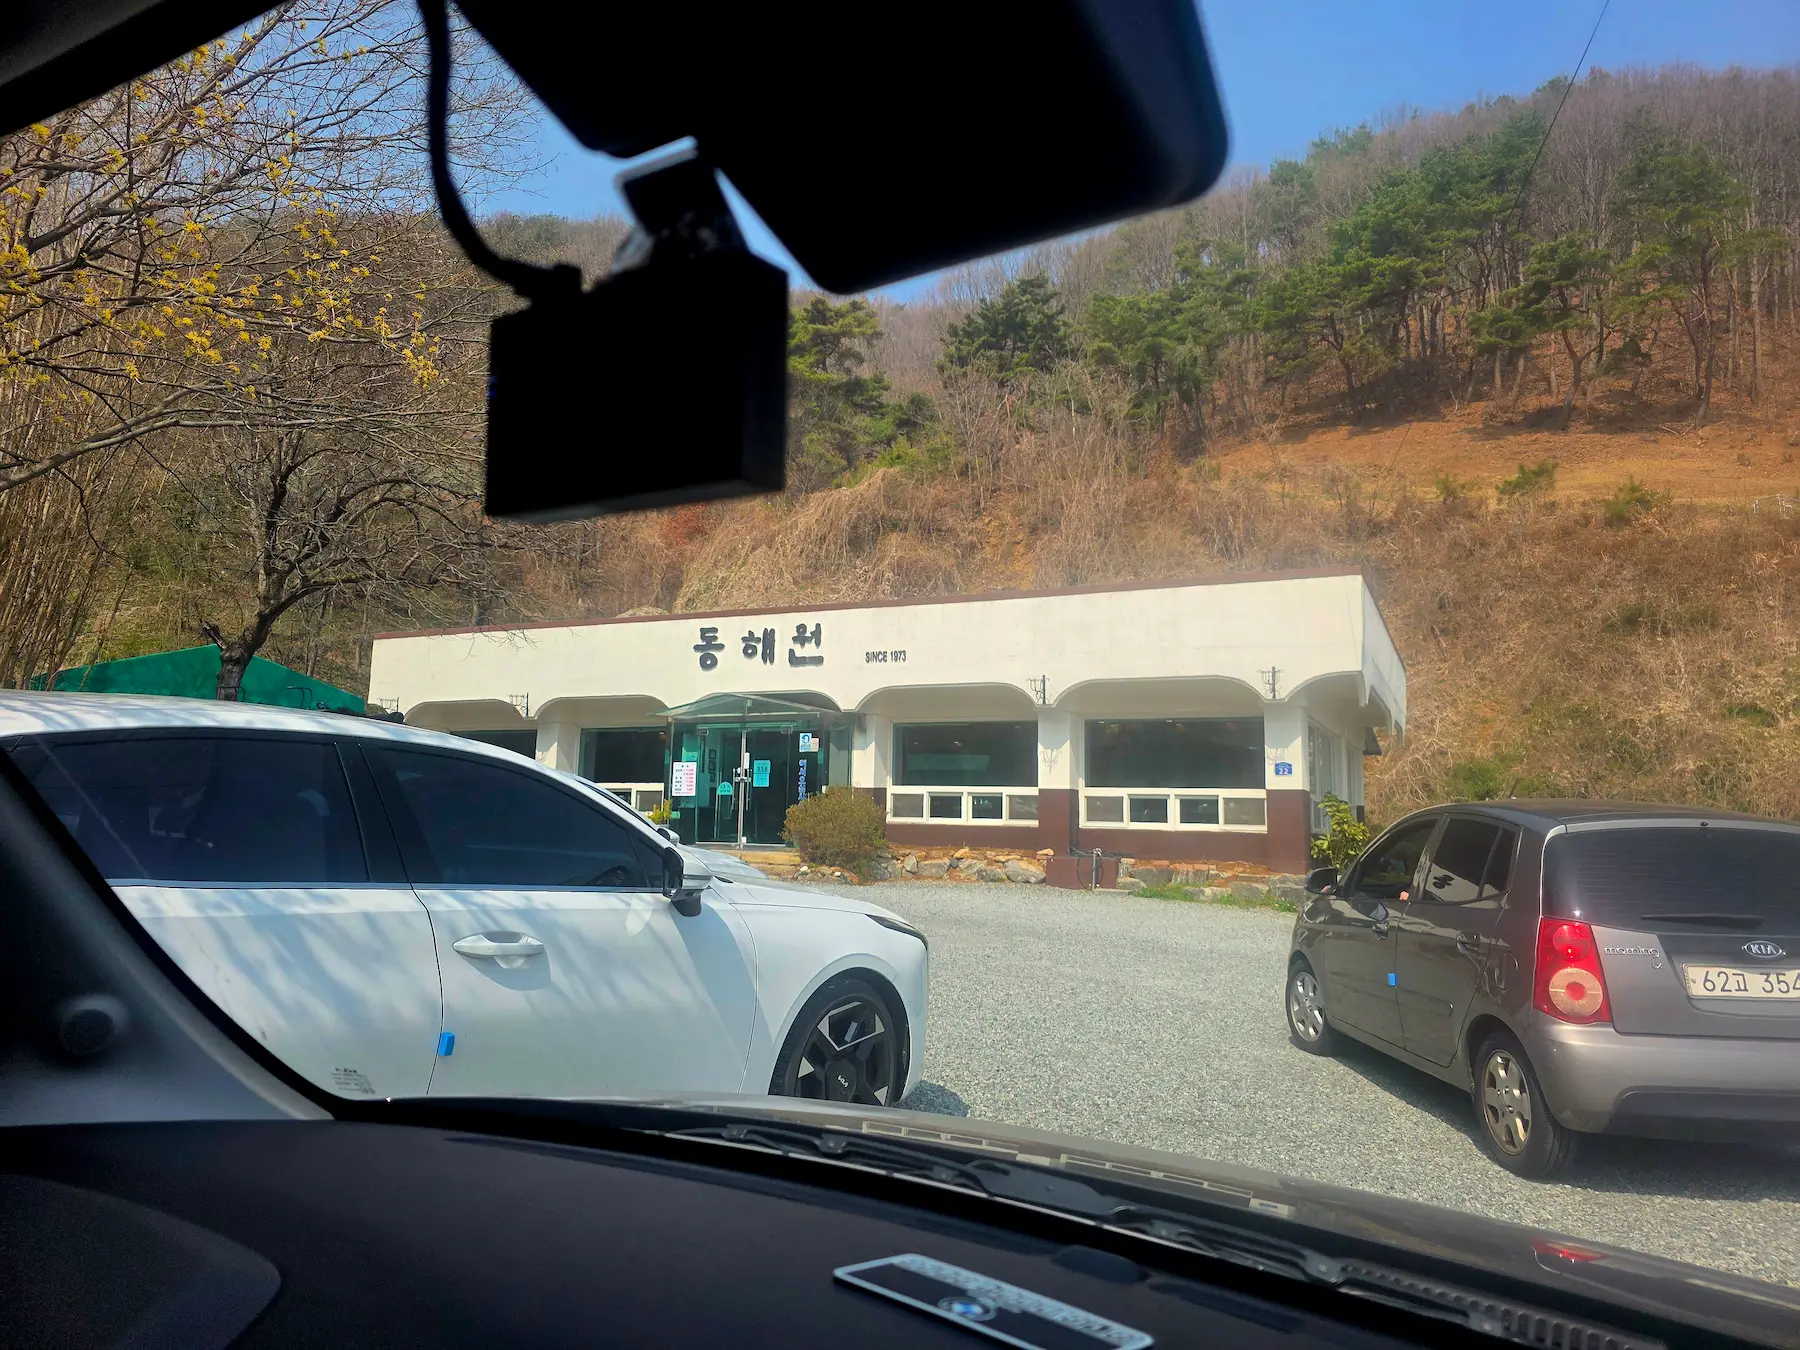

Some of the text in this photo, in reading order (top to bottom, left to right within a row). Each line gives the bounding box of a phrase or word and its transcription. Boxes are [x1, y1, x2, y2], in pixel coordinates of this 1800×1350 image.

[693, 622, 824, 671] 동해원
[865, 650, 907, 663] SINCE 1973
[1278, 767, 1289, 775] 22
[1604, 945, 1660, 958] morning
